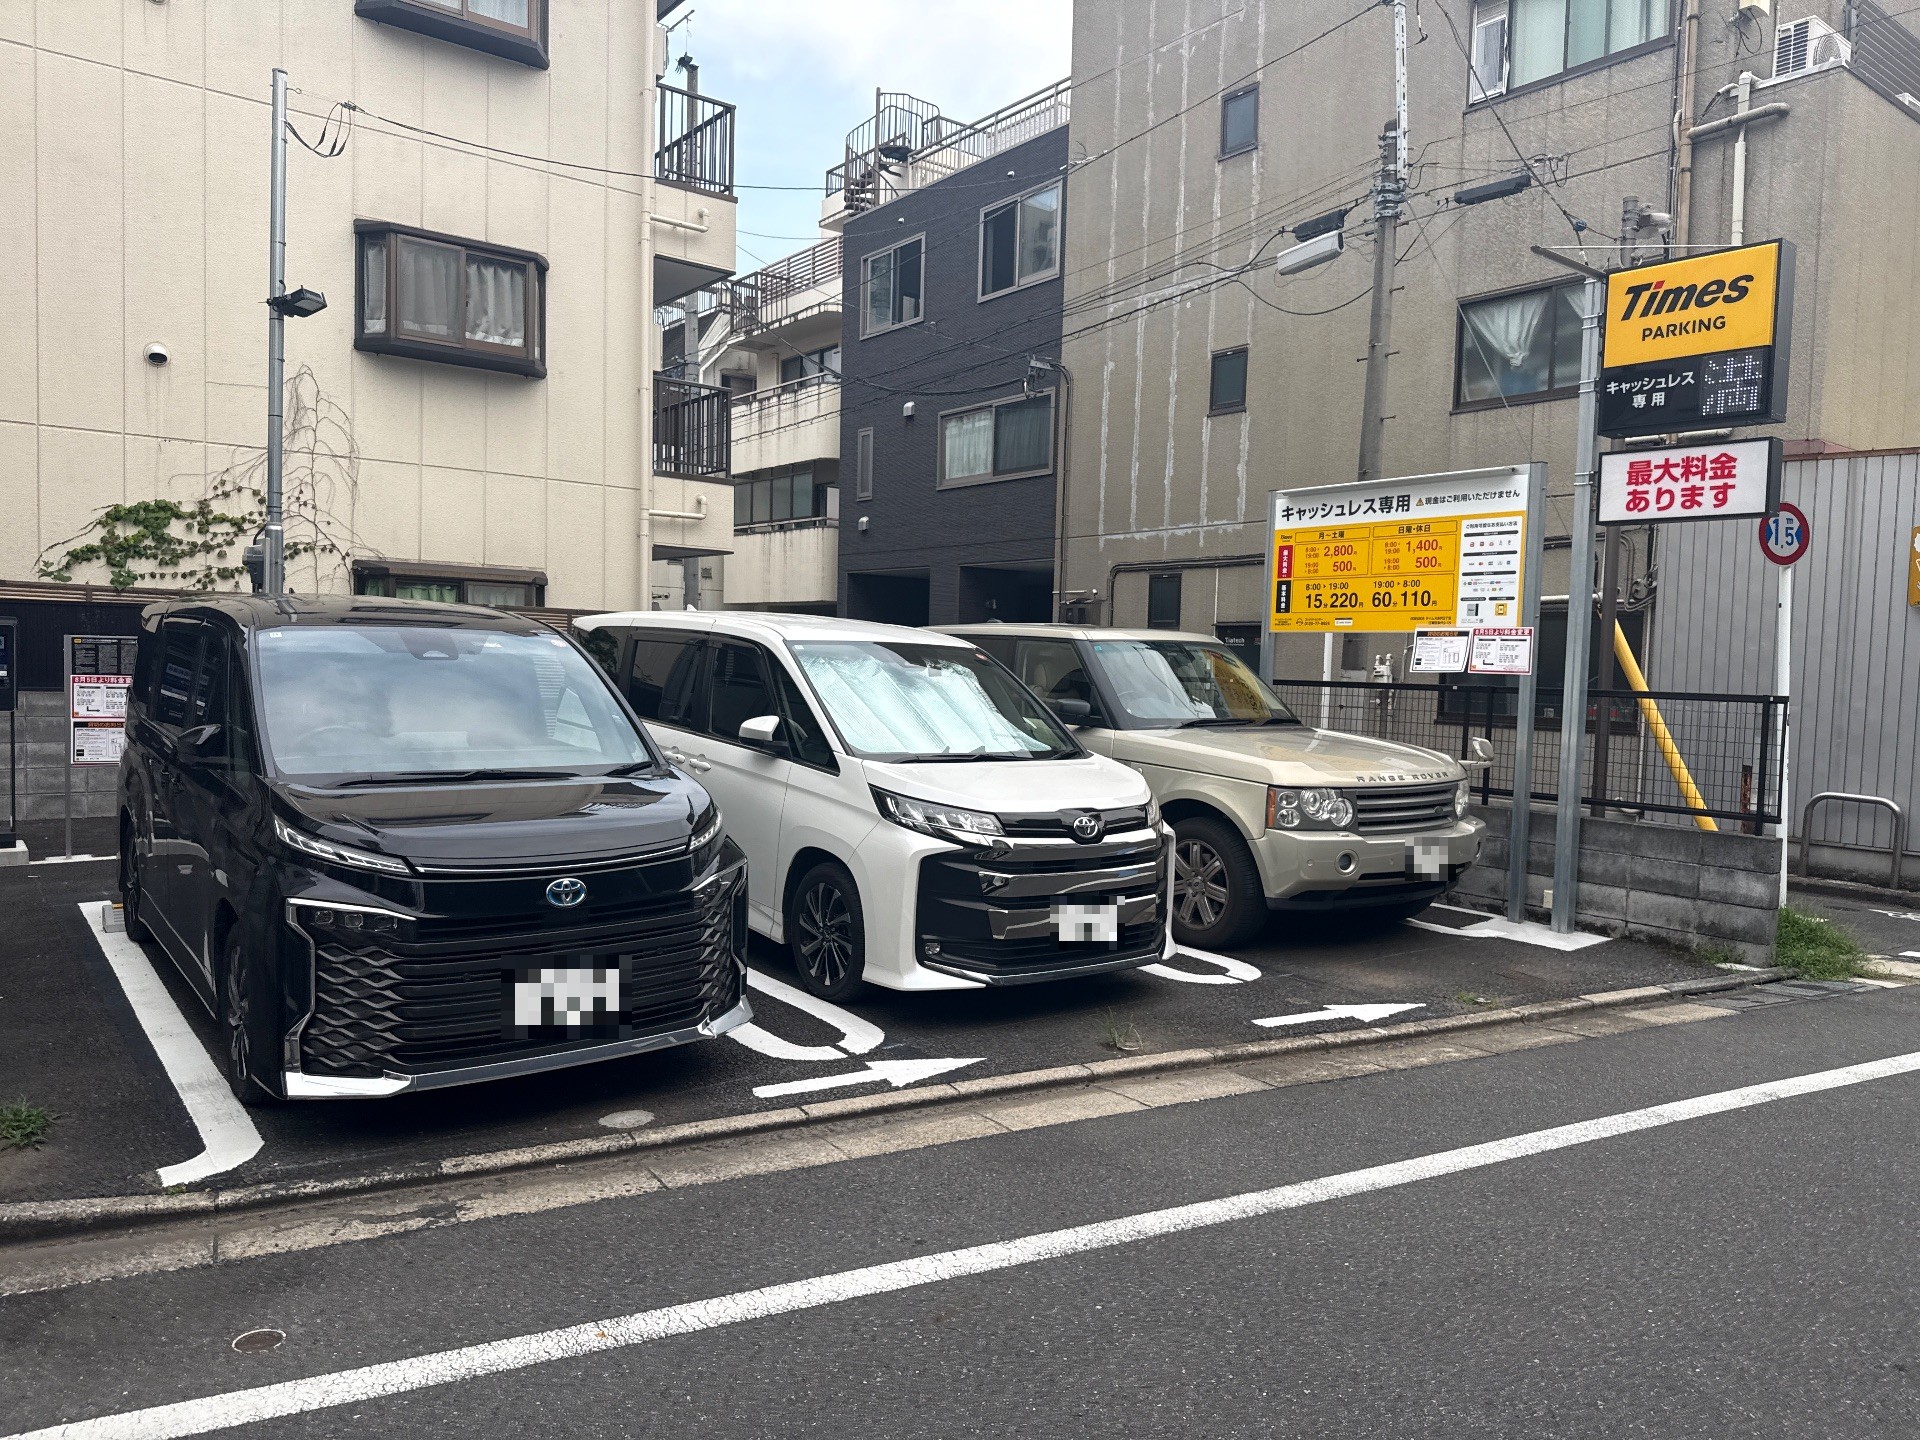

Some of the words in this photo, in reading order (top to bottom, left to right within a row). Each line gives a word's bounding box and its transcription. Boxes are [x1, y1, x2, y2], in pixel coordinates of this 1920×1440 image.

[1621, 274, 1754, 321] Times
[1641, 315, 1726, 342] PARKING
[1606, 371, 1695, 394] キャッシュレス
[1702, 355, 1762, 416] 満
[1632, 392, 1665, 409] 専用
[1626, 452, 1737, 486] 最大料金
[1281, 494, 1411, 521] キャッシュレス専用
[1424, 489, 1520, 506] 現金はご利用いただけません
[1625, 483, 1736, 513] あります
[1305, 583, 1321, 591] 8:00
[1329, 582, 1349, 590] 19:00
[1373, 580, 1395, 588] 19:00
[1403, 579, 1421, 588] 8:00
[73, 676, 133, 684] 8月5日より料金変
[1355, 775, 1406, 783] RANGE
[1411, 771, 1449, 781] ROVER
